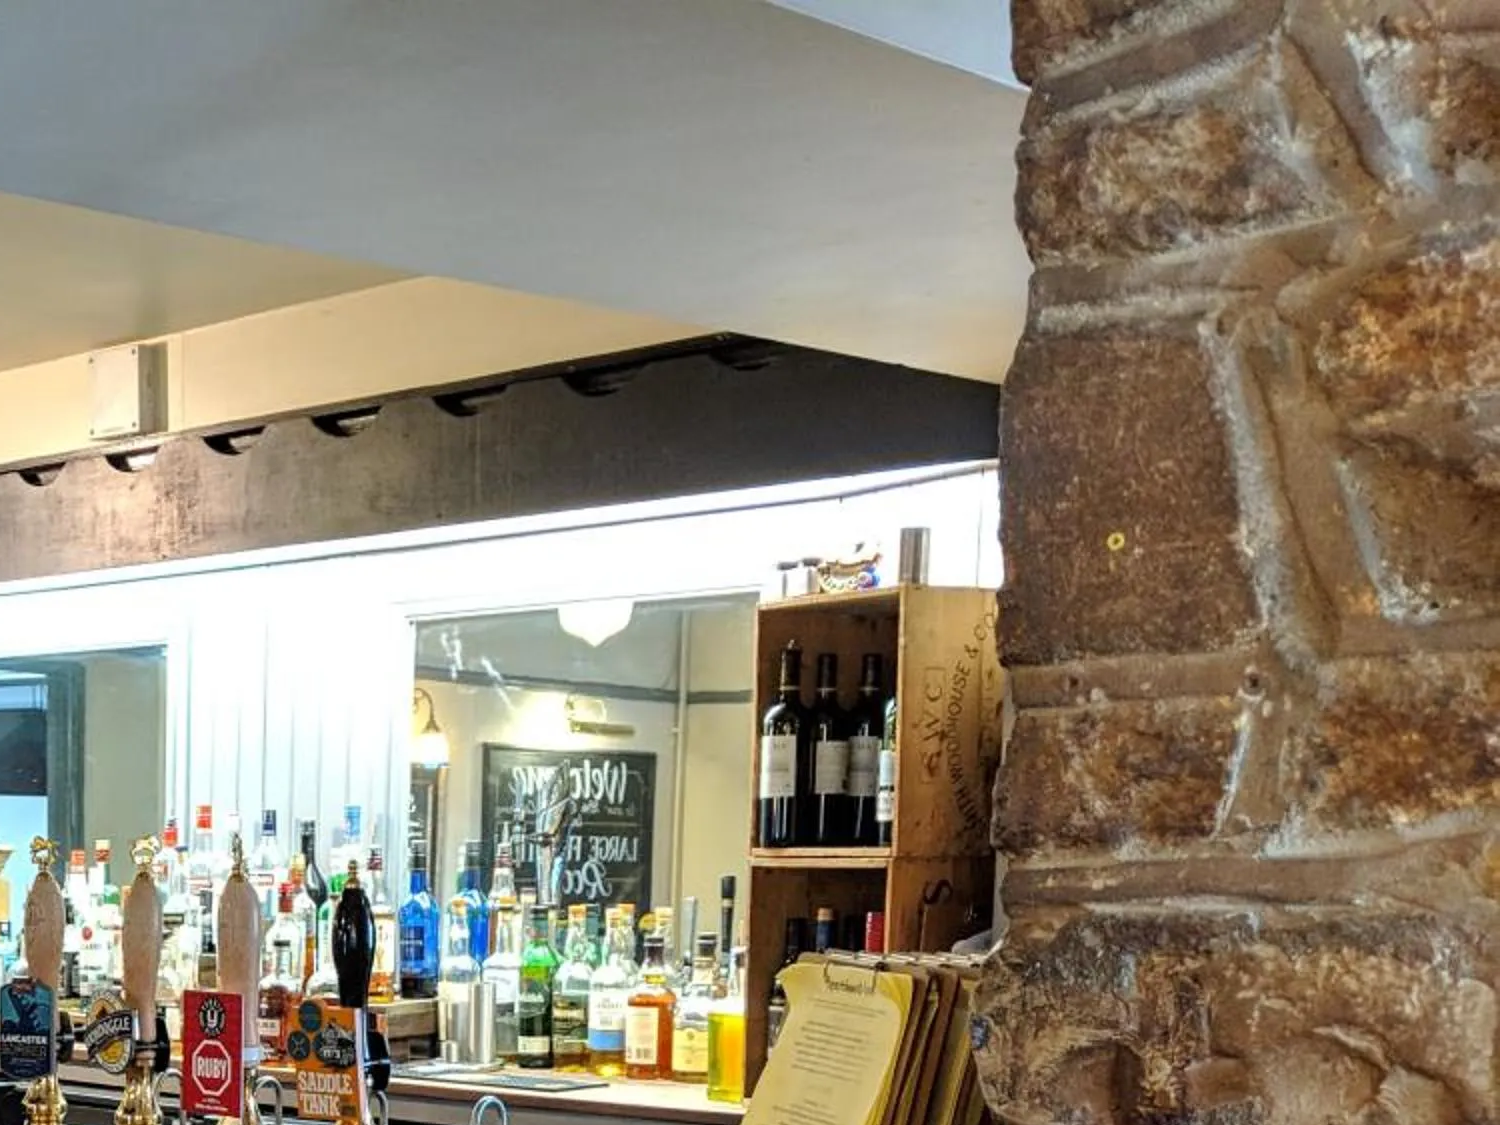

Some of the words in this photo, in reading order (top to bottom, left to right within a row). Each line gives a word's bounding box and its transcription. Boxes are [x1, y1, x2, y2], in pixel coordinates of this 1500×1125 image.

[1, 1033, 47, 1046] LANCASTER
[196, 1057, 228, 1081] RUBY
[297, 1071, 353, 1096] SADDLE
[301, 1094, 342, 1118] TANK
